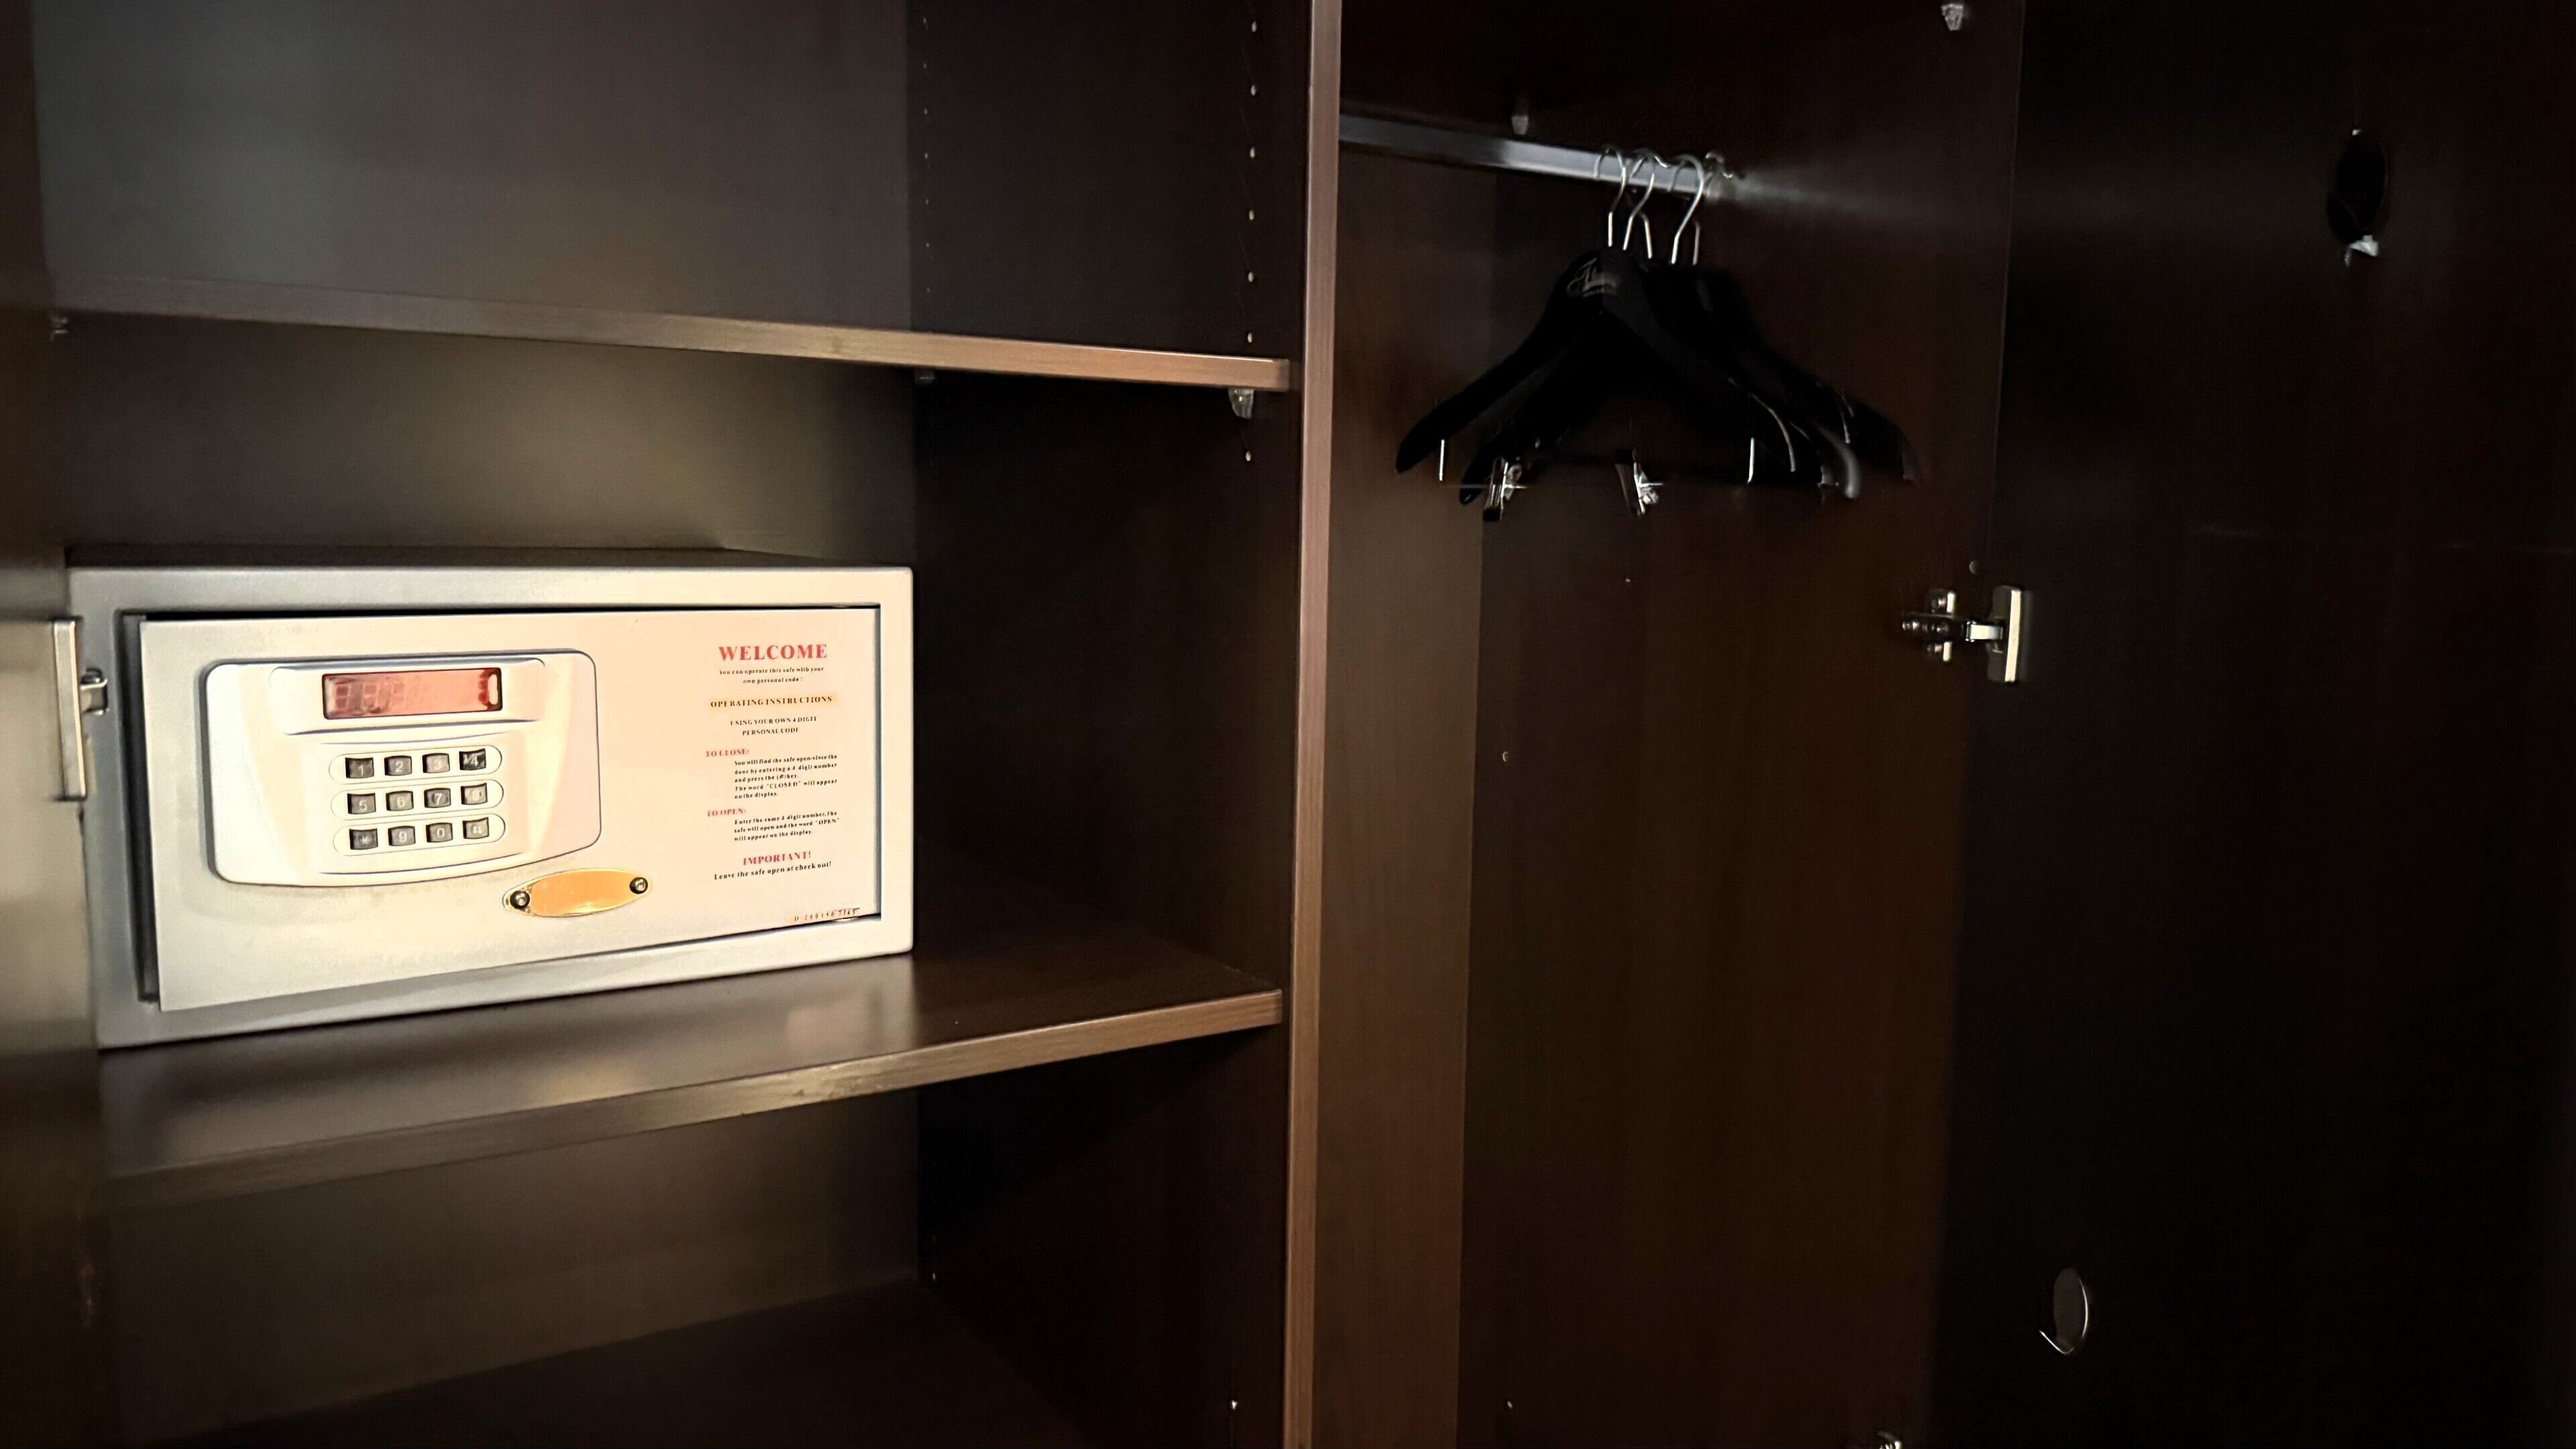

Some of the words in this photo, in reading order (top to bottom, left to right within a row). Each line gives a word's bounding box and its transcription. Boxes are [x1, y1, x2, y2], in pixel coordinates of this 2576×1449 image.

[718, 644, 827, 661] WELCOME
[710, 698, 763, 708] OPERATING
[766, 696, 833, 705] INSTRUCTIONS
[396, 761, 403, 772] 2
[433, 759, 441, 770] 3
[397, 796, 405, 808] 6
[434, 793, 442, 805] 7
[359, 800, 368, 811] 5
[399, 831, 407, 843] 9
[437, 827, 445, 839] 0
[743, 851, 811, 865] IMPORTANT!
[767, 867, 785, 875] open
[795, 862, 815, 871] check
